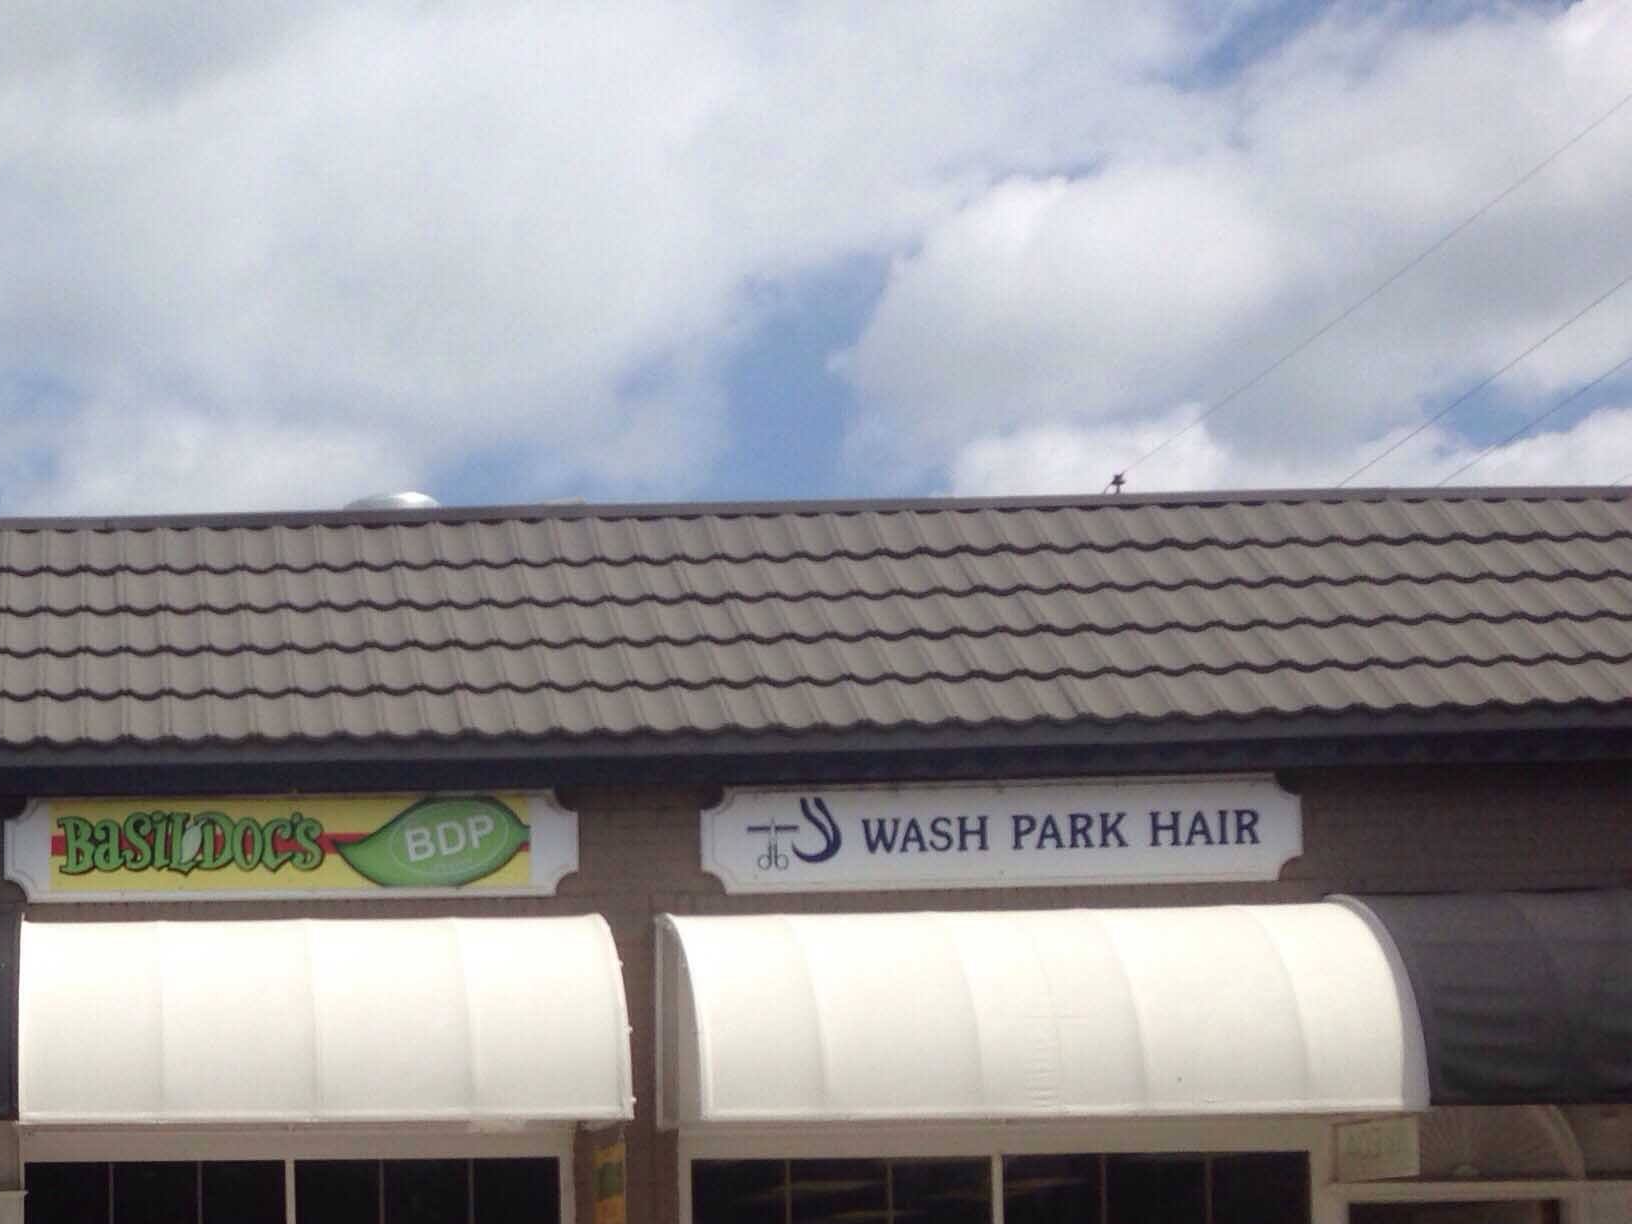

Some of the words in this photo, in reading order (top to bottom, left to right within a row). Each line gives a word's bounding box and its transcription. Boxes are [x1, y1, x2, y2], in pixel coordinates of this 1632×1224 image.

[405, 815, 494, 862] BDP
[861, 814, 989, 854] WASH
[1012, 812, 1128, 850] PARK
[1148, 809, 1261, 847] HAIR
